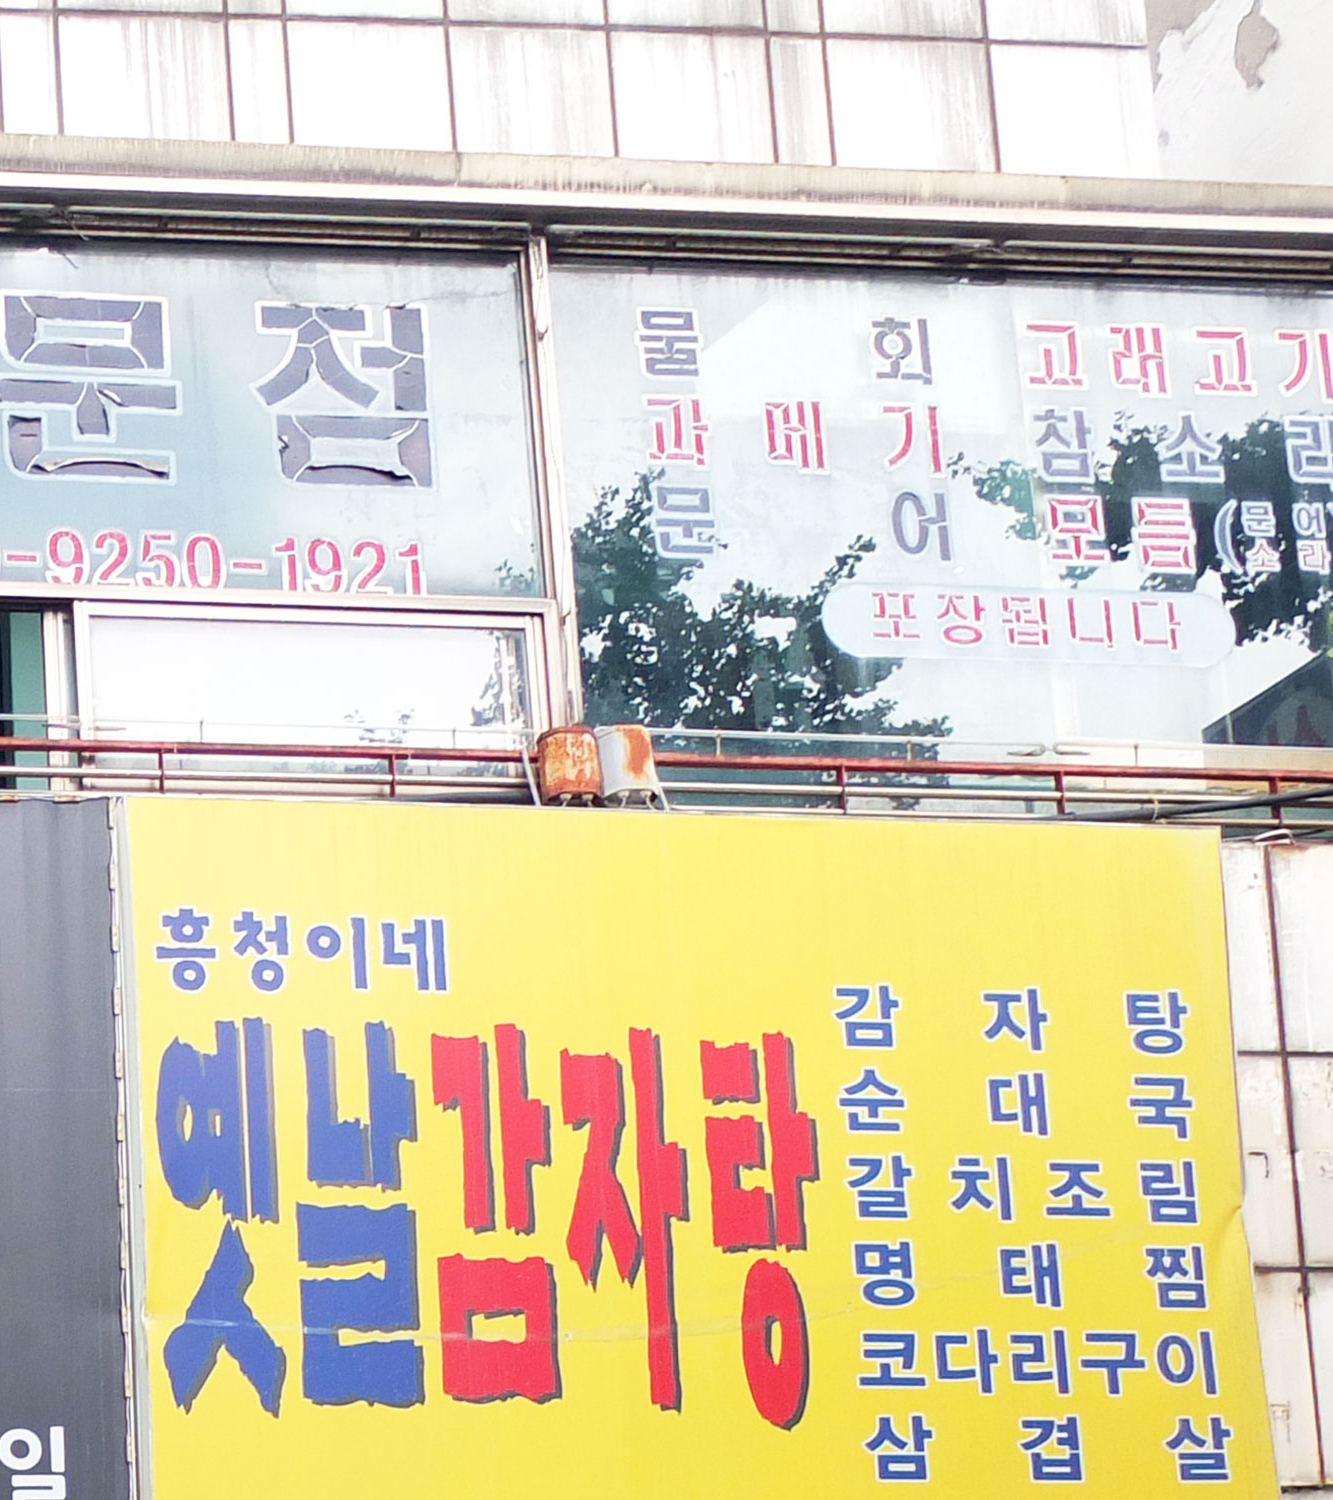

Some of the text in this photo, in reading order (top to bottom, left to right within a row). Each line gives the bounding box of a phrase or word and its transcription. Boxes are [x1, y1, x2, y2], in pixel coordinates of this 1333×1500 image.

[871, 591, 1182, 651] 포장됩니다
[155, 907, 447, 992] 흥청이네
[858, 1327, 1219, 1396] 코다리구이
